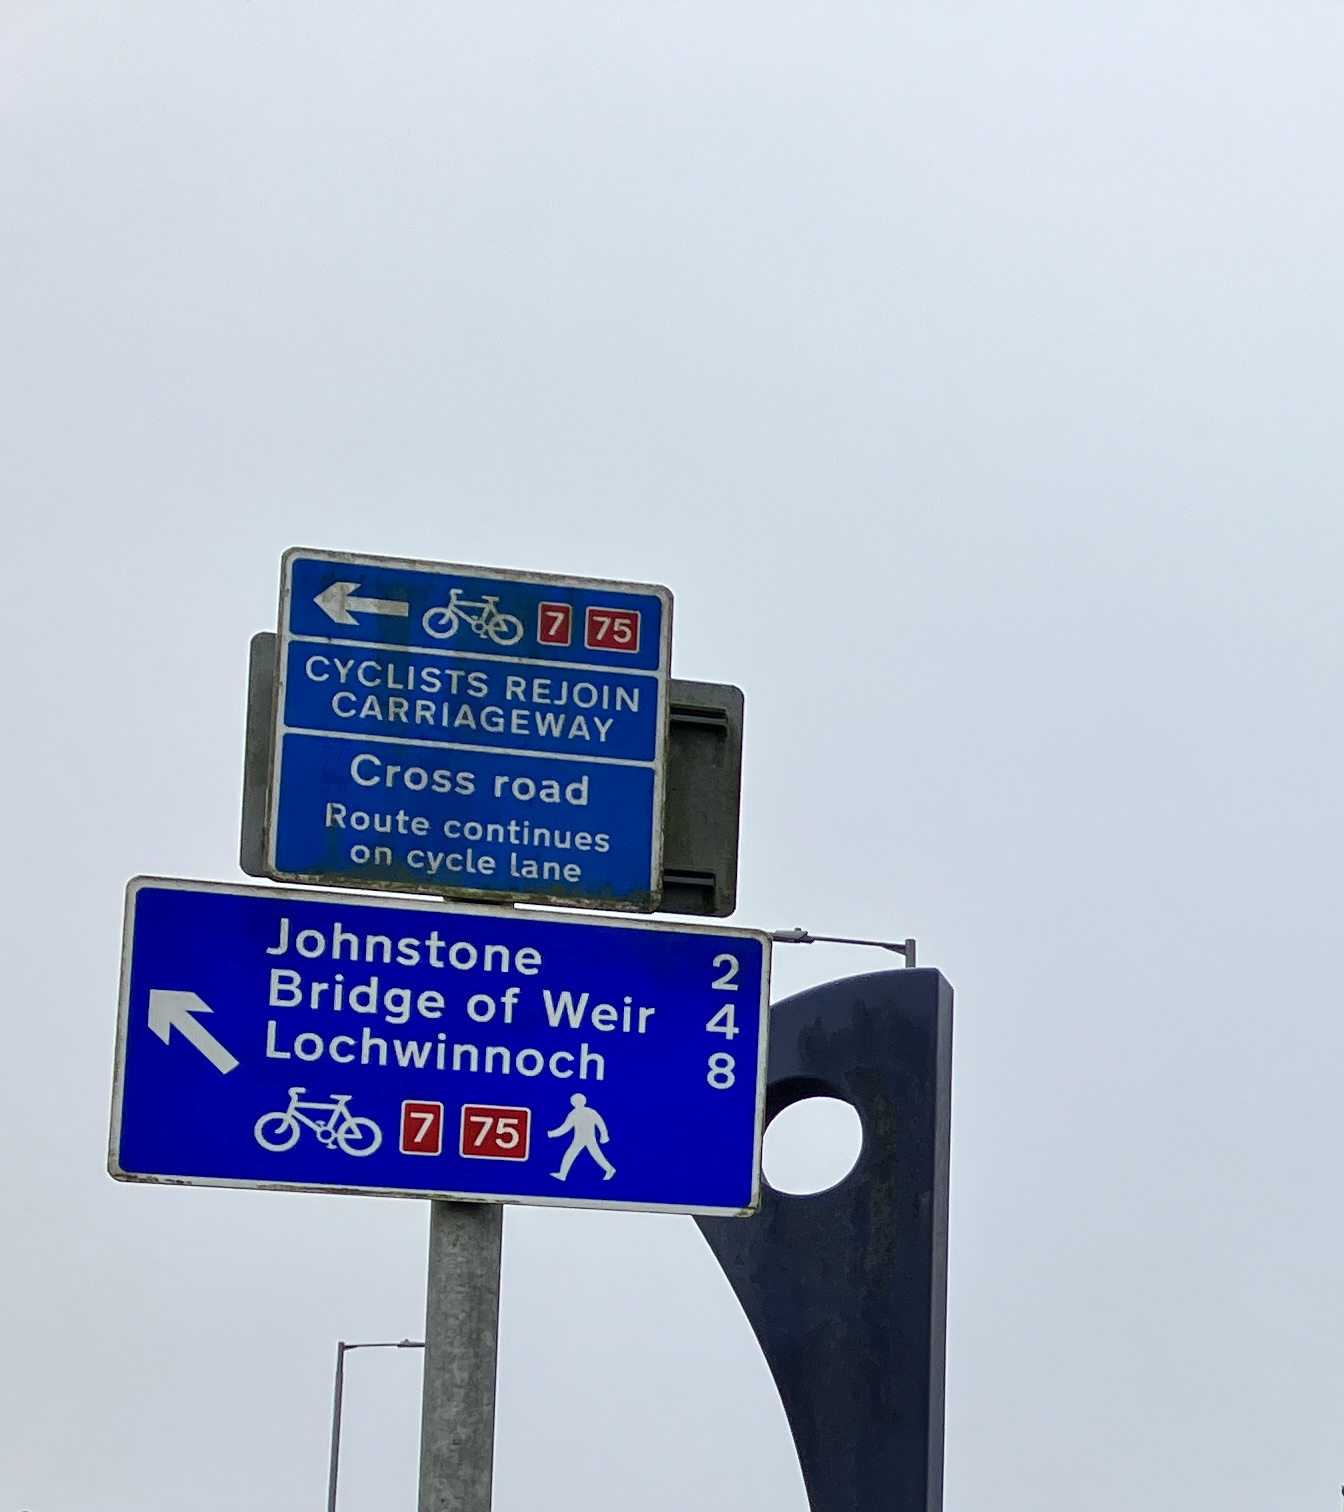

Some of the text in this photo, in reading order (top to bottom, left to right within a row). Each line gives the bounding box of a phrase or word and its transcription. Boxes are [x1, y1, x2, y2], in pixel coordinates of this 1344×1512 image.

[546, 612, 631, 643] 7 75
[306, 656, 639, 712] CYCLISTS REJOIN
[332, 692, 614, 742] CARRIAGEWAY
[351, 754, 588, 805] Cross road
[326, 803, 609, 852] Route continues
[351, 845, 581, 882] on cycle lane
[266, 918, 738, 990] Johnstone 2
[269, 969, 739, 1039] Bridge of Weir 4
[267, 1020, 735, 1089] Lochwinnoch 8
[411, 1112, 519, 1148] 7 75
